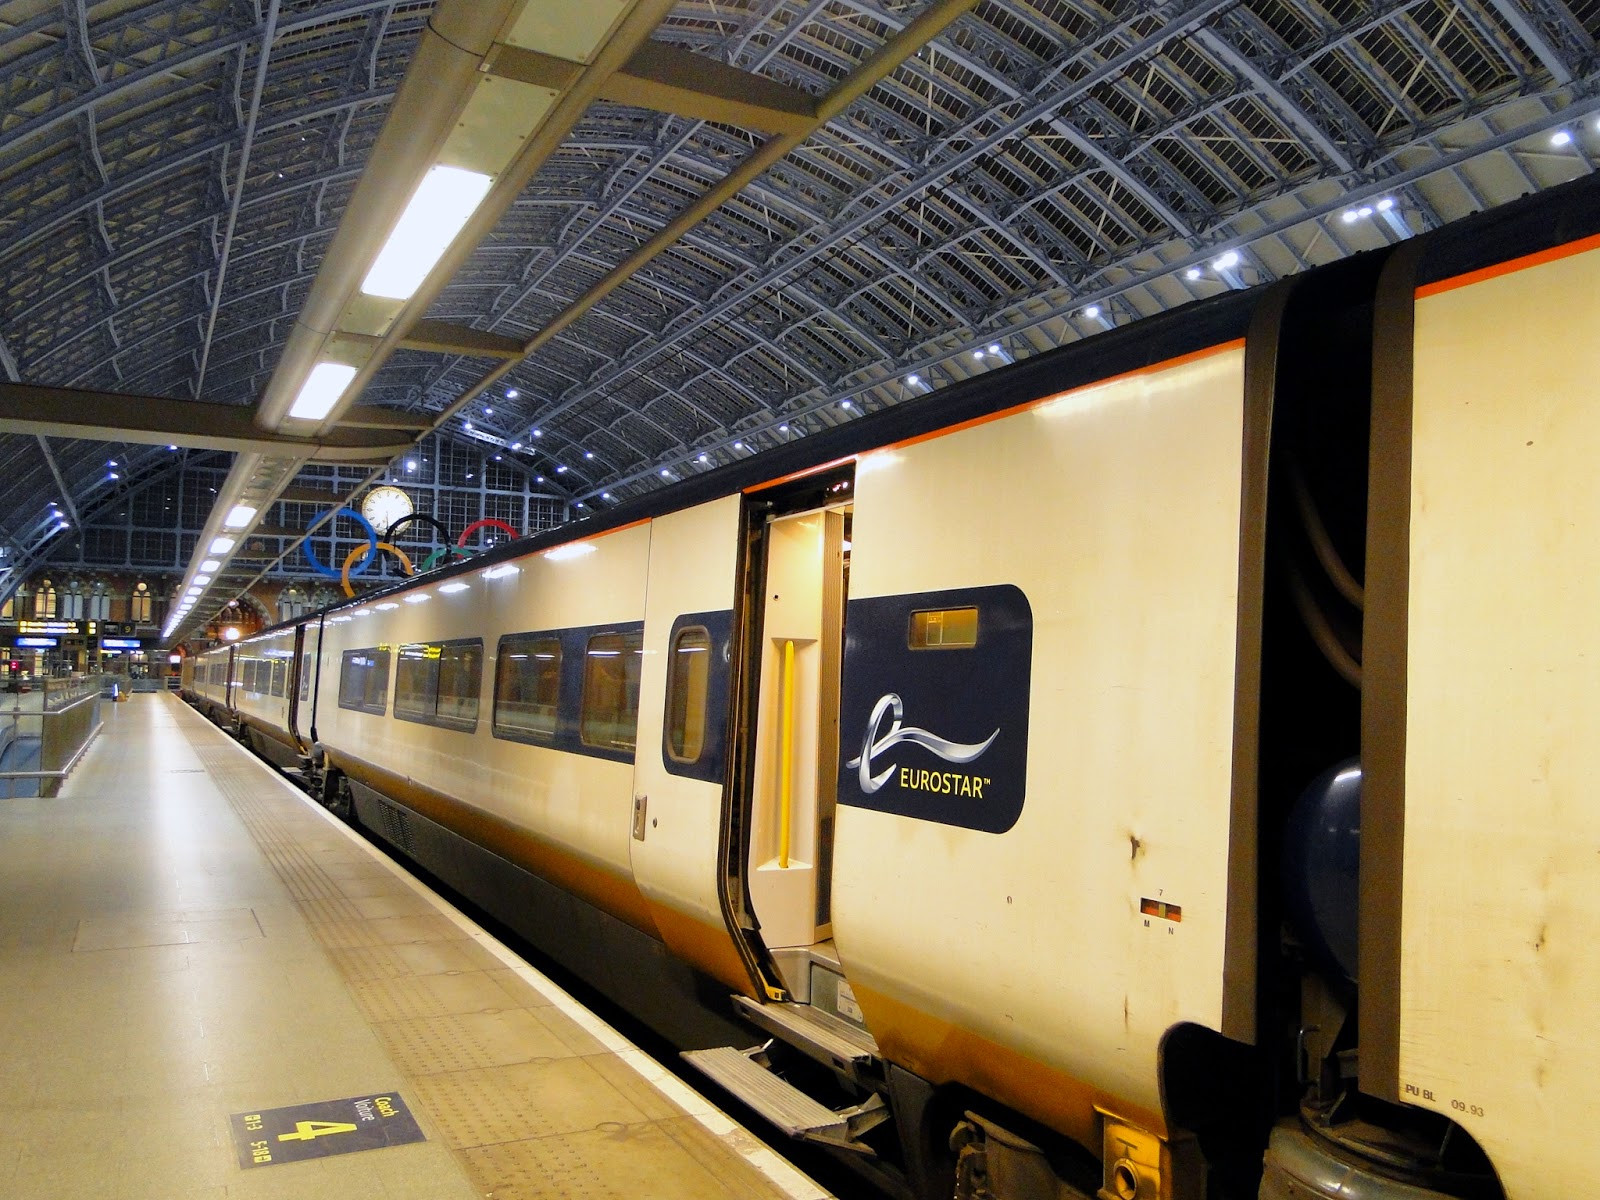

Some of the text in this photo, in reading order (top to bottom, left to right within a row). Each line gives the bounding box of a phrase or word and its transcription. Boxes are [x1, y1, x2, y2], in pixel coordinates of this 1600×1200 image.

[124, 625, 132, 634] 9
[1158, 888, 1164, 897] 7
[1143, 919, 1151, 928] M
[1168, 927, 1174, 935] N
[374, 1096, 400, 1118] Coach
[1405, 1083, 1484, 1118] PU BL 09.93
[354, 1099, 376, 1122] Voiture
[245, 1119, 264, 1131] 1-3
[277, 1120, 358, 1142] 4
[250, 1140, 270, 1156] 5-18
